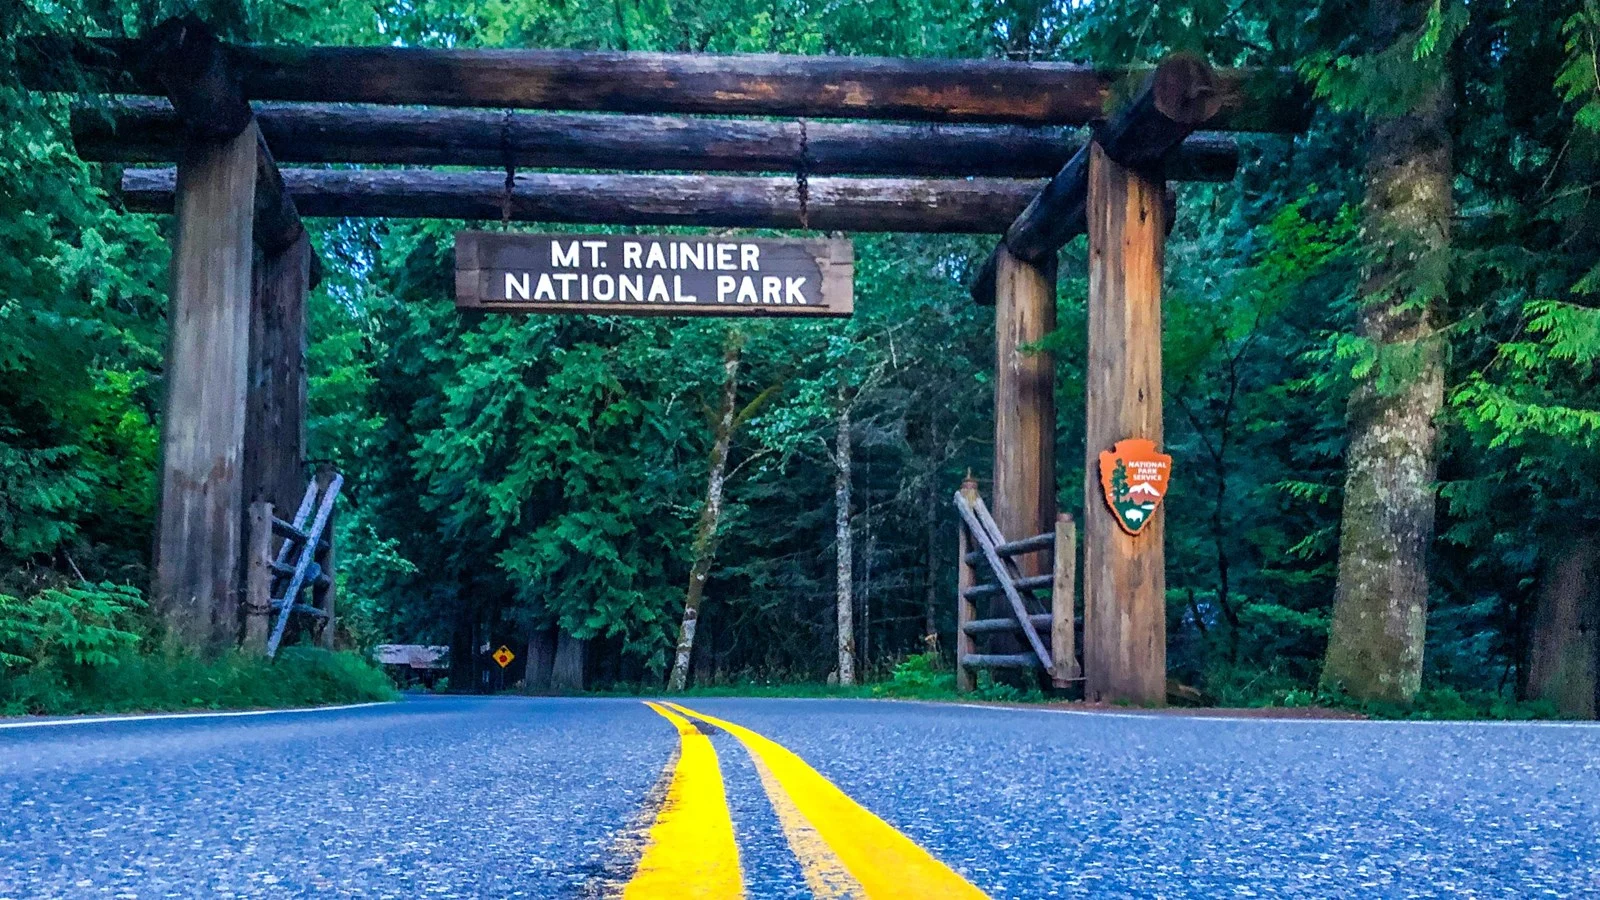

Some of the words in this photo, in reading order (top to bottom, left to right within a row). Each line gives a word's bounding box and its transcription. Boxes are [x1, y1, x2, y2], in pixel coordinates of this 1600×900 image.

[550, 240, 607, 268] MT.
[623, 241, 760, 271] RAINIER
[504, 272, 697, 303] NATIONAL
[717, 275, 807, 304] PARK
